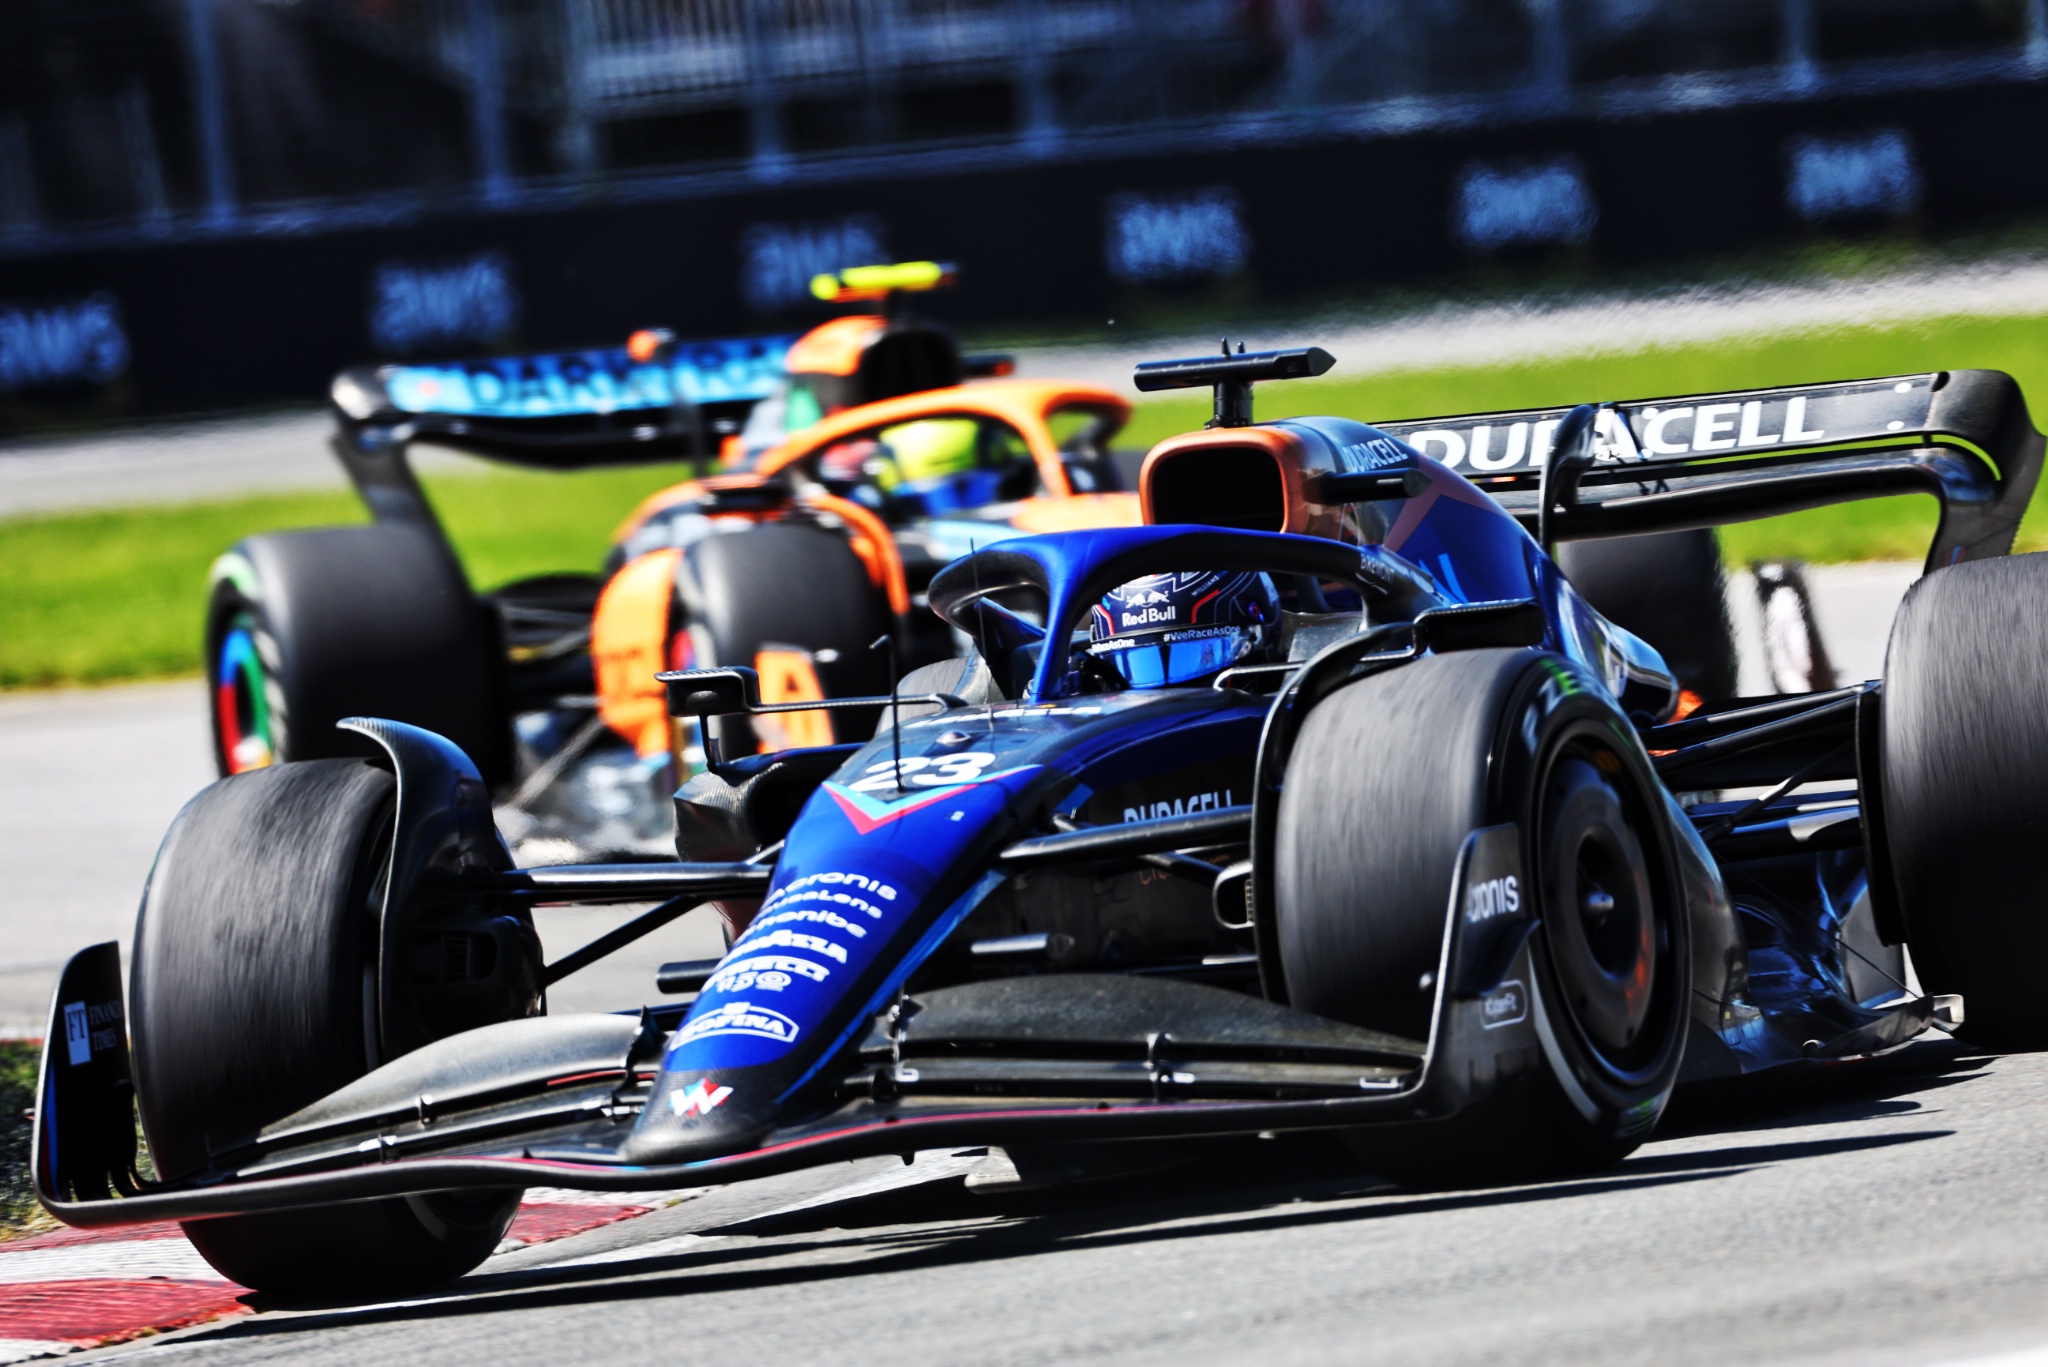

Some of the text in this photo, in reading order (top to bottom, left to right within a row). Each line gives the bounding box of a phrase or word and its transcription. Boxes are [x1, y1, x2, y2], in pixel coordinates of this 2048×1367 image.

[1122, 606, 1176, 627] Red Bull
[1163, 625, 1241, 642] #WeRaceAsOne
[848, 752, 996, 792] 23
